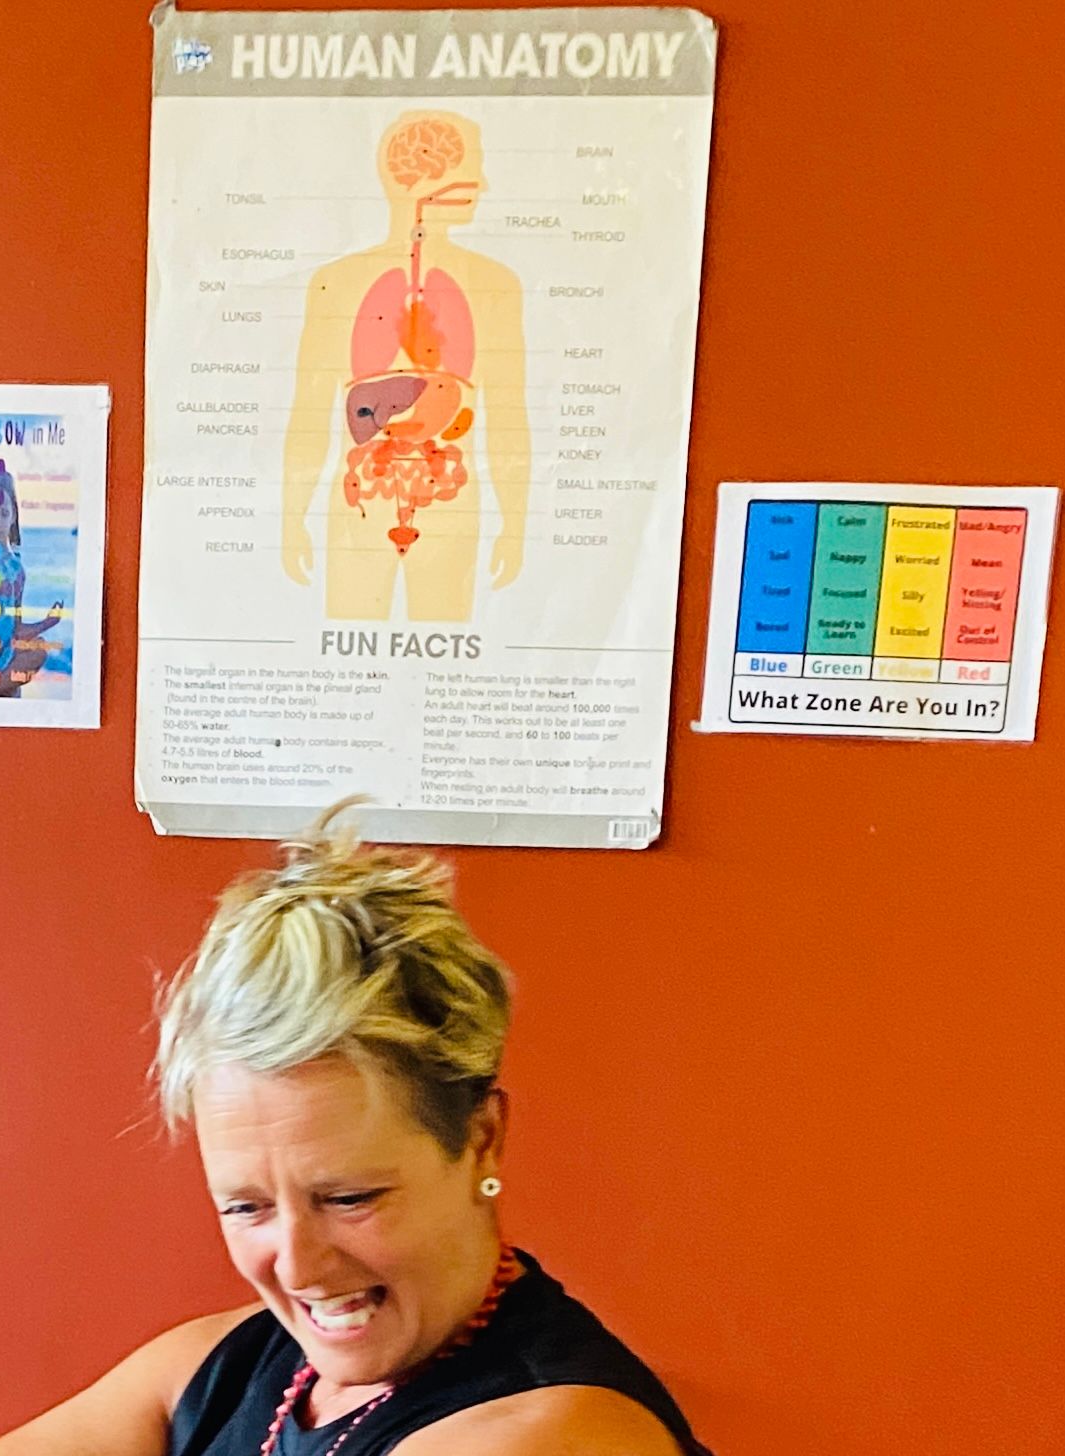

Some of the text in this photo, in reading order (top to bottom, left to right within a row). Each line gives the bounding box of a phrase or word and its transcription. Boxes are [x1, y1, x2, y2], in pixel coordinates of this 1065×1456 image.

[231, 33, 417, 79] HUMAN
[427, 31, 685, 79] ANATOMY
[576, 146, 614, 158] BRAIN
[225, 193, 266, 205] TONSIL
[582, 194, 626, 206] MOUTH
[505, 216, 561, 228] TRACHEA
[572, 231, 625, 242] THYROID
[222, 248, 295, 260] ESOPHAGUS
[199, 281, 226, 292] SKIN
[549, 286, 604, 297] BRONCHI
[222, 311, 262, 322] LUNGS
[564, 348, 603, 358] HEART
[191, 363, 260, 374] DIAPHRAGM
[562, 384, 621, 395] STOMACH
[176, 402, 259, 413] GALLBLADDER
[561, 405, 595, 416] LIVER
[33, 426, 44, 445] in
[48, 421, 66, 445] Me
[197, 425, 258, 435] PANCREAS
[560, 426, 606, 437] SPLEEN
[558, 450, 602, 460] KIDNEY
[157, 476, 256, 487] LARGE INTESTINE
[557, 479, 658, 491] SMALL INTESTINE
[198, 507, 255, 518] APPENDIX
[554, 508, 602, 519] URETER
[892, 518, 951, 530] Frustrated
[553, 535, 608, 546] BLADDER
[206, 542, 254, 552] RECTUM
[895, 555, 940, 566] Worried
[902, 590, 926, 603] Silly
[321, 630, 482, 660] FUN FACTS
[750, 657, 788, 672] Blue
[812, 660, 862, 675] Green
[878, 662, 934, 678] Yellow
[312, 669, 335, 680] body
[957, 666, 991, 681] Red
[548, 690, 577, 700] heart.
[738, 690, 1000, 717] What Zone Are You In?
[526, 730, 538, 739] 60
[554, 731, 571, 740] 100
[536, 759, 570, 768] unique
[161, 775, 198, 785] oxygen
[570, 786, 609, 795] breathe
